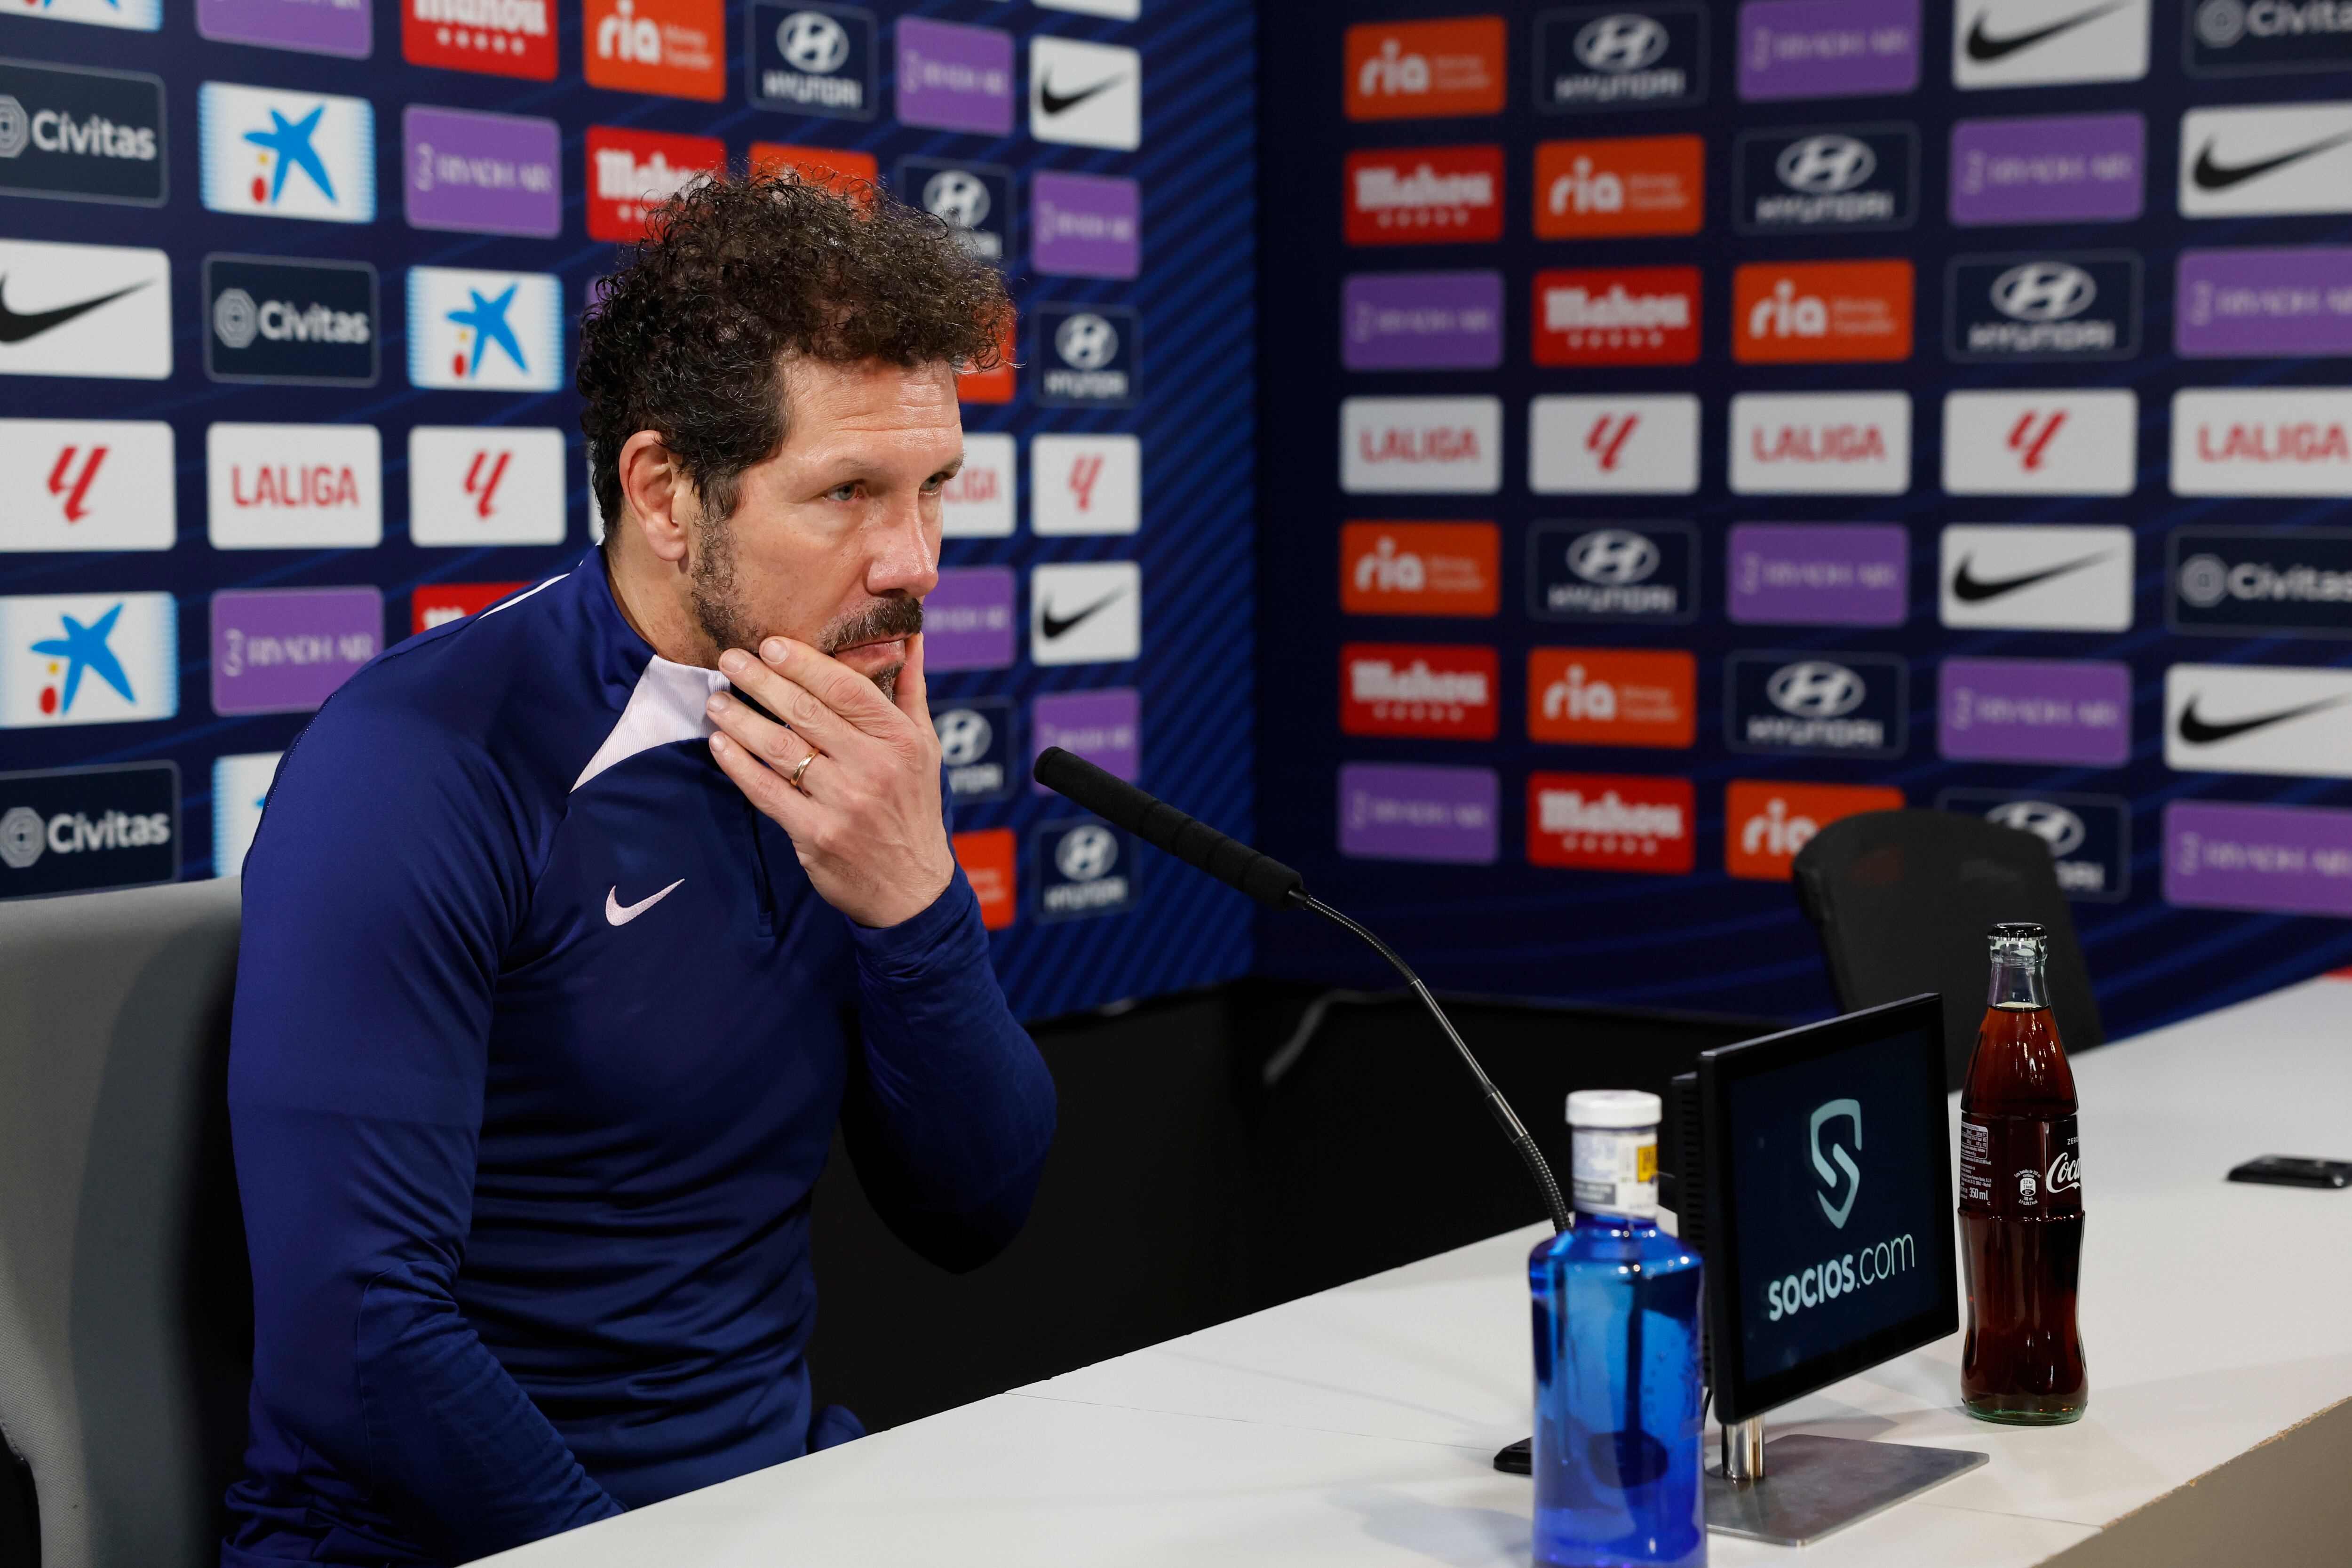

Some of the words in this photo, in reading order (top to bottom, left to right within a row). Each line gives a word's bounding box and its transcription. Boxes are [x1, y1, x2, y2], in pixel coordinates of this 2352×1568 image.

[596, 0, 660, 65] ria
[1360, 40, 1431, 94] ria
[1550, 158, 1624, 213] ria
[1750, 281, 1828, 337] ria
[1360, 428, 1478, 462] LALIGA
[1752, 425, 1884, 462] LALIGA
[2197, 422, 2350, 463] LALIGA
[231, 464, 359, 509] LALIGA
[1356, 538, 1426, 590] ria
[1544, 666, 1617, 719] ria
[1969, 1187, 1979, 1199] 350
[1979, 1190, 1988, 1201] ml
[1768, 1233, 1915, 1321] SOCIOS.com
